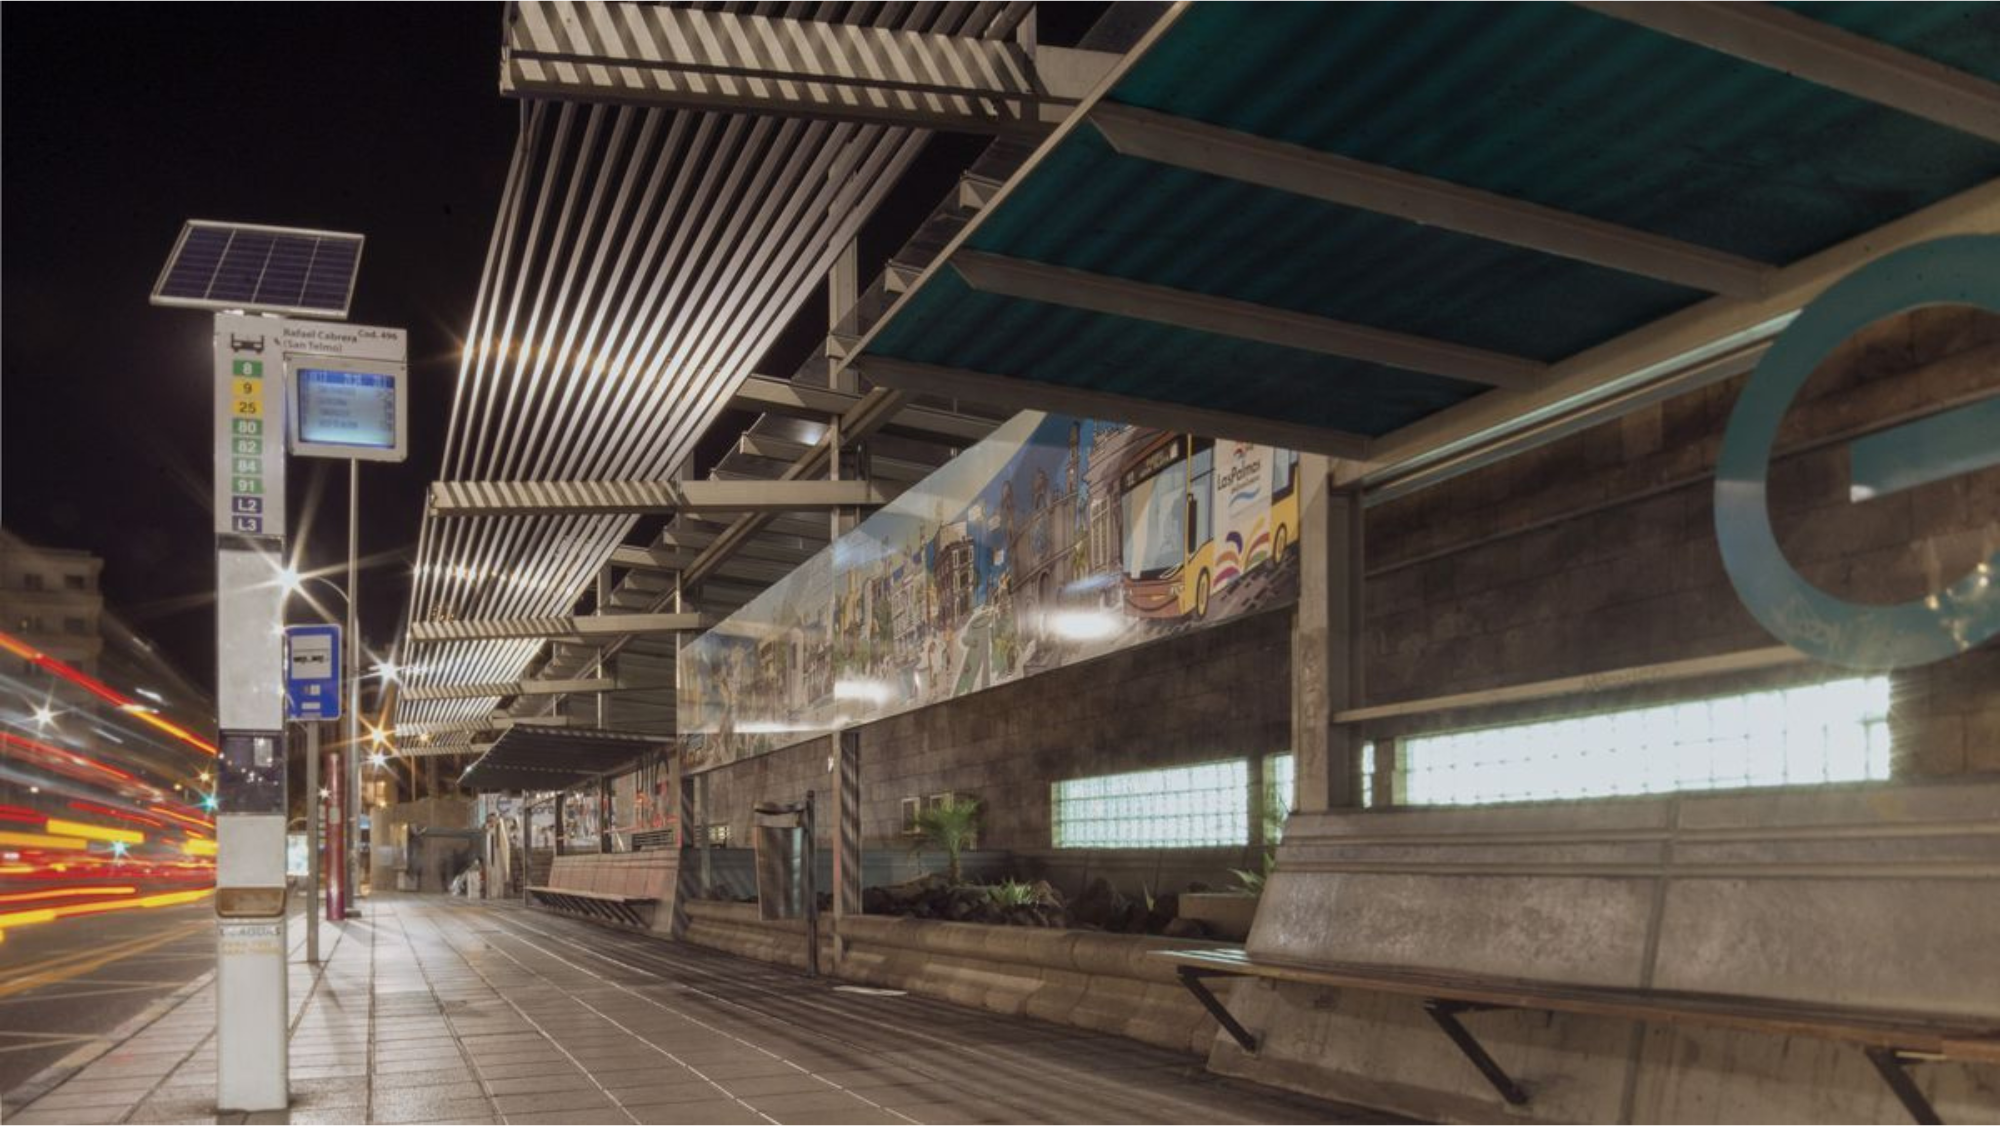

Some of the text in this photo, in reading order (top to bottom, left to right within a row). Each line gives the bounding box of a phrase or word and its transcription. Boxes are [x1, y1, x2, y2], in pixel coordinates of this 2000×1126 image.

[282, 328, 358, 343] Rafael Cabrera
[242, 361, 253, 375] 8
[242, 381, 253, 395] 9
[239, 401, 257, 414] 25
[238, 420, 257, 433] 80
[238, 440, 256, 453] 82
[238, 459, 256, 472] 84
[238, 479, 255, 492] 91
[238, 499, 256, 512] L2
[238, 518, 256, 531] L3
